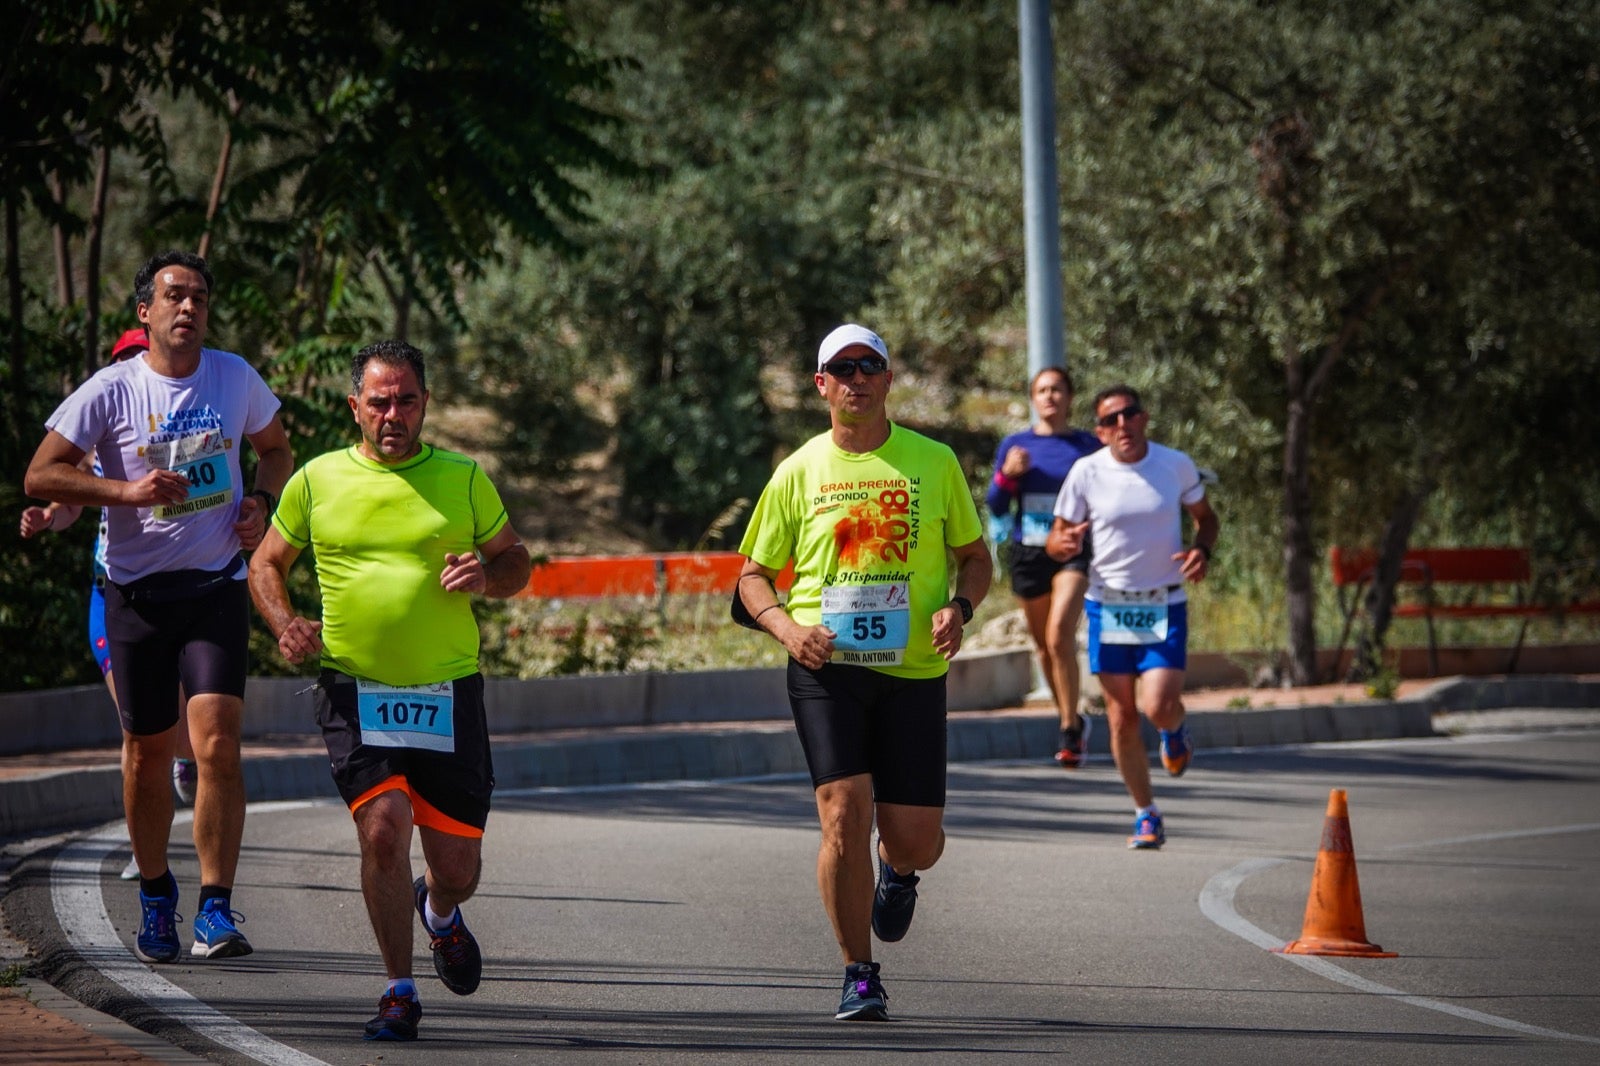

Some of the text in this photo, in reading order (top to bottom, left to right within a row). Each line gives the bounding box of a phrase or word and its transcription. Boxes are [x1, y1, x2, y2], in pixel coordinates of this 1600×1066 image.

[167, 408, 216, 421] CARRERA
[820, 479, 907, 494] GRAN PREMIO
[162, 493, 226, 518] ANTONIO EDUARDO
[814, 492, 869, 506] DE FONDO
[910, 477, 921, 550] SANTA FE
[879, 489, 911, 563] 2018
[852, 616, 887, 641] 55
[1113, 610, 1157, 628] 1026
[843, 651, 896, 663] JUAN ANTONIO
[376, 702, 439, 727] 1077
